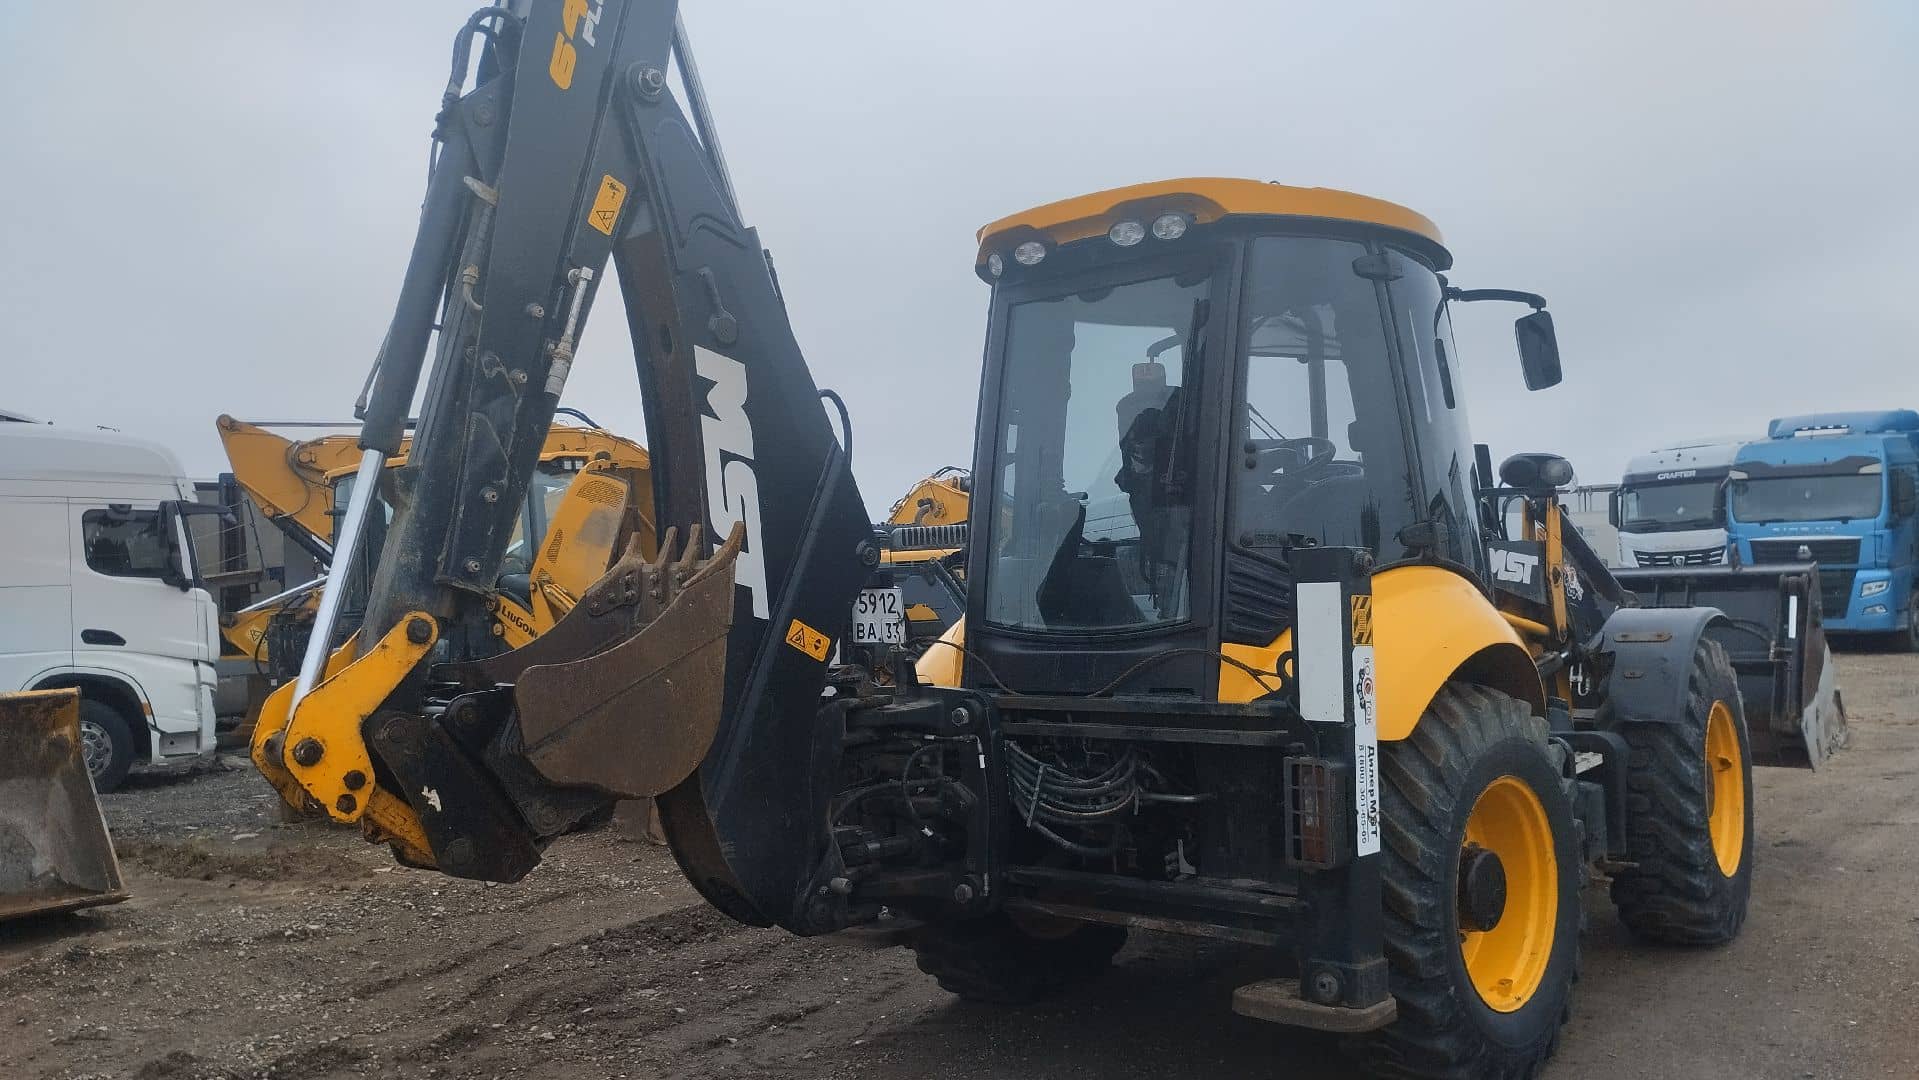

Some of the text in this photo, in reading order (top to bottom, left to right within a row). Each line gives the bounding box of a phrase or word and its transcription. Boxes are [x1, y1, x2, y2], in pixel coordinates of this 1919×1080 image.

[582, 0, 604, 48] PL
[694, 345, 769, 620] MST
[1489, 548, 1538, 585] MST
[858, 593, 896, 614] 5912
[1367, 745, 1375, 797] Дилер
